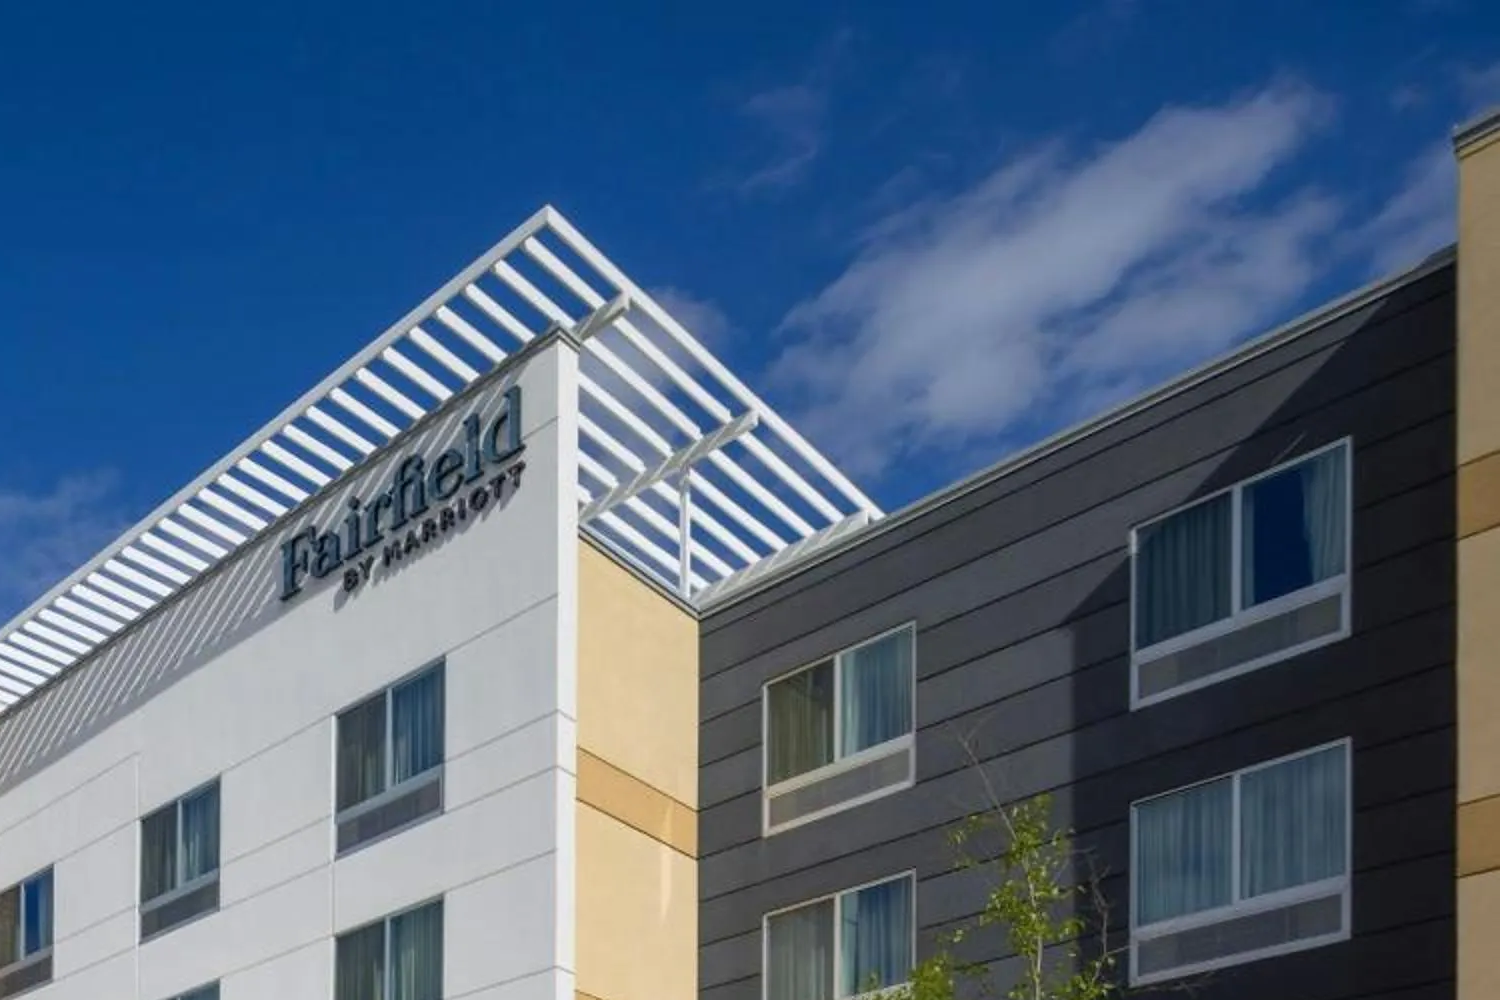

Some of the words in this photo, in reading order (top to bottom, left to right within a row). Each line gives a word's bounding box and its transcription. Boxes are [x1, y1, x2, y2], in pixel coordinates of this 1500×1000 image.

[280, 384, 527, 601] Fairfield
[343, 556, 374, 592] BY
[383, 460, 526, 567] MARRIOTT
